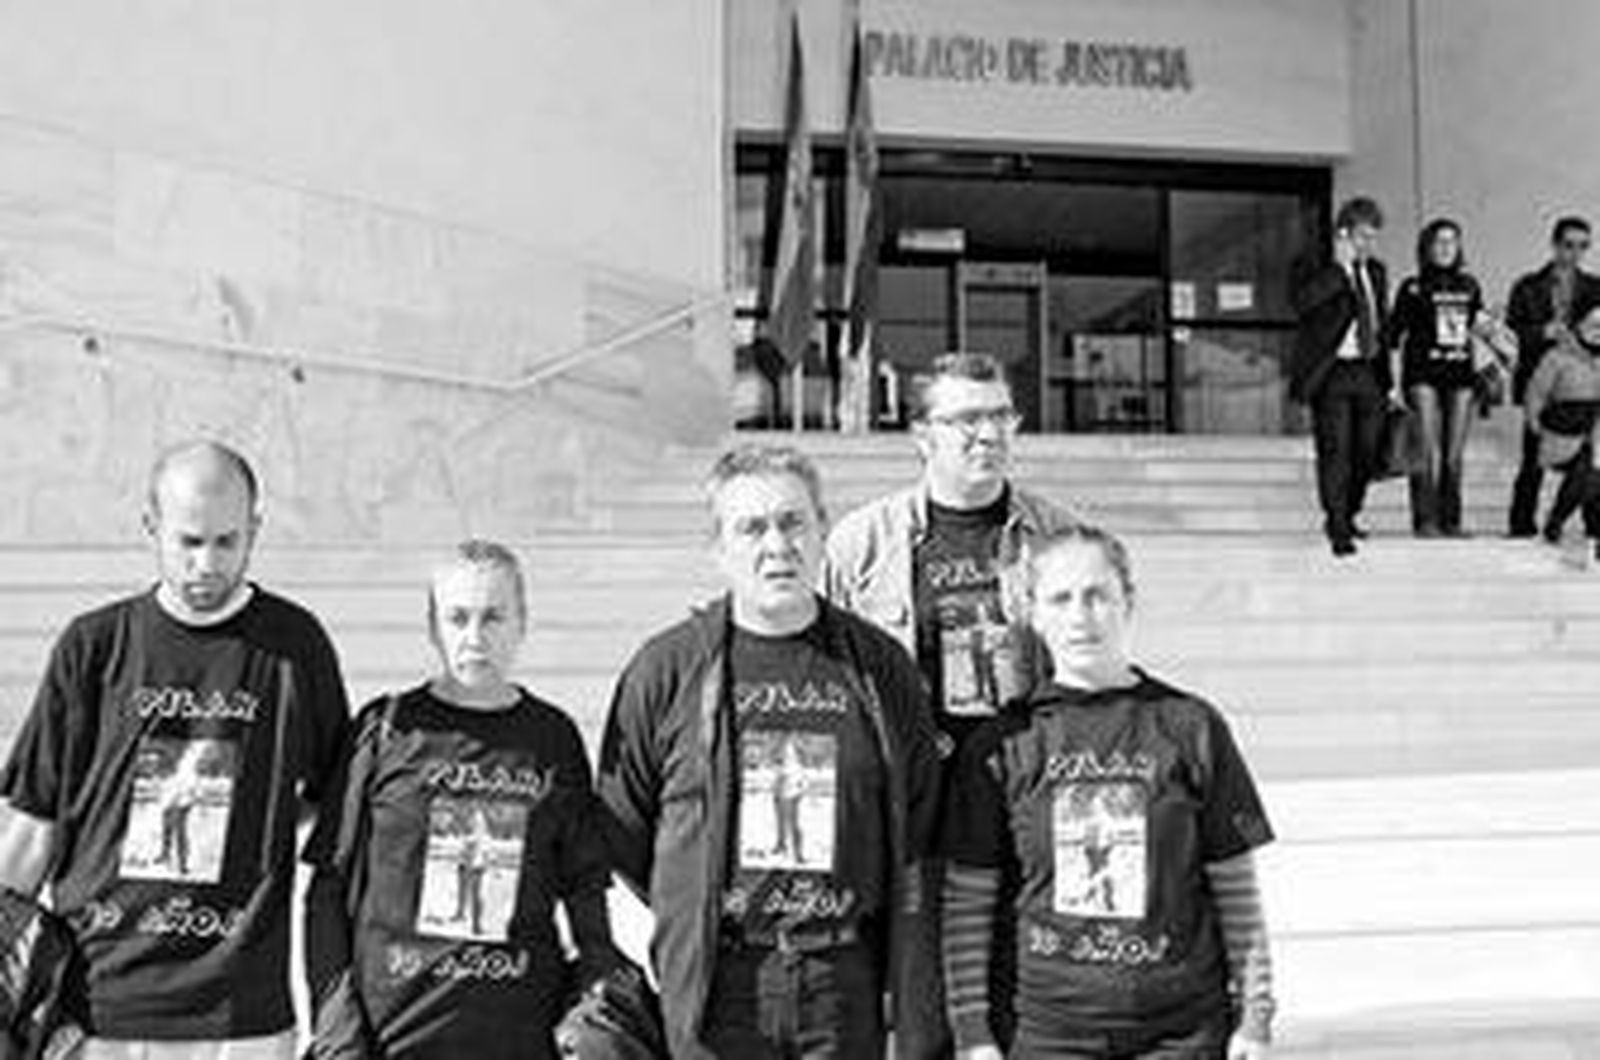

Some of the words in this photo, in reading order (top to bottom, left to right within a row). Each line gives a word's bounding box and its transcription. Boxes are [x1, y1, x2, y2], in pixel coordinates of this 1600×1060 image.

[864, 30, 997, 83] PALACIO
[1006, 37, 1049, 84] DE
[1056, 39, 1193, 92] JUSTICIA
